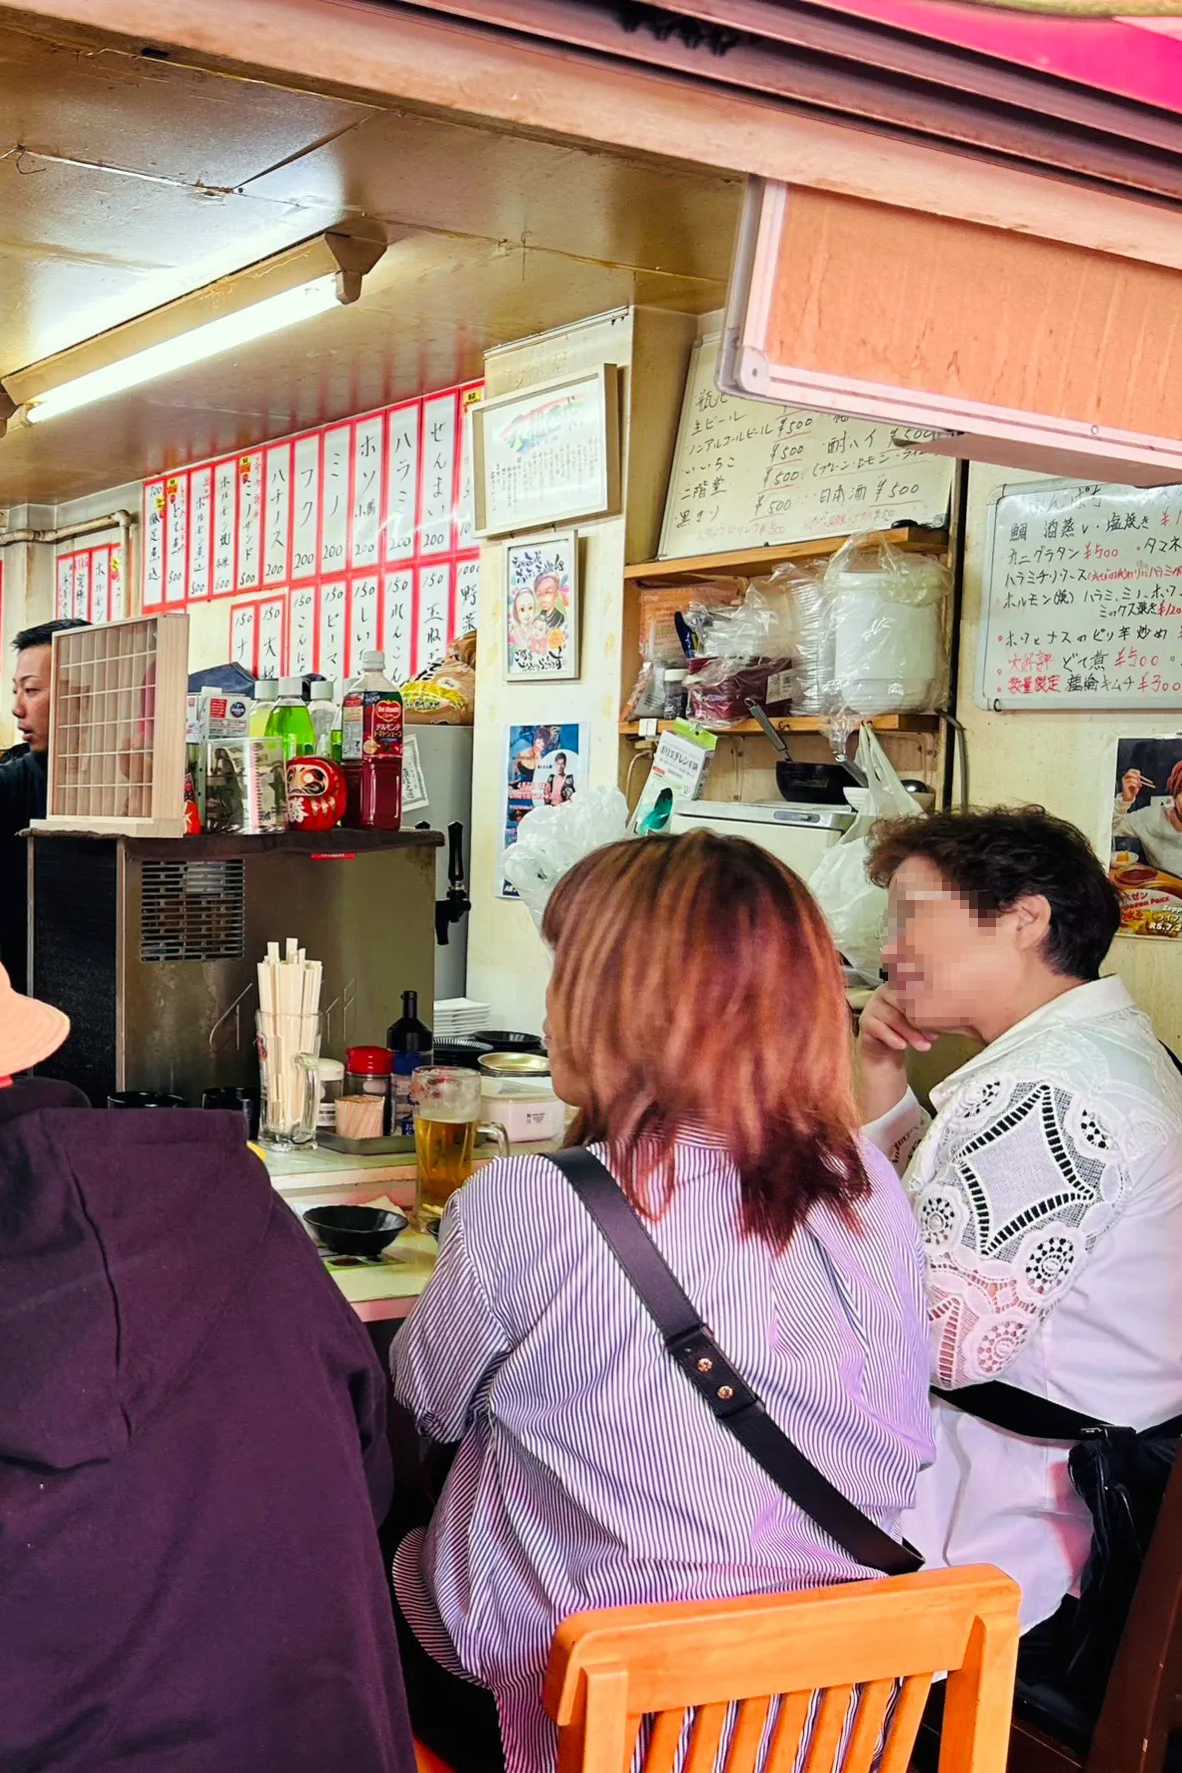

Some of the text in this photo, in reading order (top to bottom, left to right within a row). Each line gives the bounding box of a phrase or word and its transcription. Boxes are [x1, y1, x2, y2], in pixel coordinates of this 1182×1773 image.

[691, 411, 748, 436] 生ビール
[778, 417, 813, 438] ¥500
[771, 443, 804, 463] ¥500
[360, 435, 377, 494] ホソ
[395, 432, 412, 514] ハラミ
[426, 421, 446, 516] ぜんまい
[330, 452, 341, 518] ミノ
[681, 467, 800, 501] 二階堂 ¥500
[819, 479, 920, 505] 日本酒 ¥500
[300, 468, 314, 528] フク
[754, 495, 792, 516] ¥500
[270, 468, 286, 549] ハチノス
[354, 543, 376, 556] 200
[423, 533, 445, 548] 200
[294, 552, 315, 570] 200
[322, 544, 343, 561] 200
[1009, 545, 1080, 565] カニグラタン
[1084, 542, 1119, 560] ¥500
[239, 571, 255, 586] 500
[265, 563, 284, 577] 200
[422, 571, 444, 589] 150
[325, 586, 344, 602] 150
[354, 581, 375, 598] 150
[387, 576, 408, 593] 150
[293, 594, 312, 608] 150
[235, 612, 253, 627] 150
[263, 606, 281, 622] 150
[1063, 650, 1109, 672] どて煮
[1115, 647, 1159, 667] ¥500
[1008, 675, 1061, 694] 数量限定
[1138, 672, 1182, 692] ¥300
